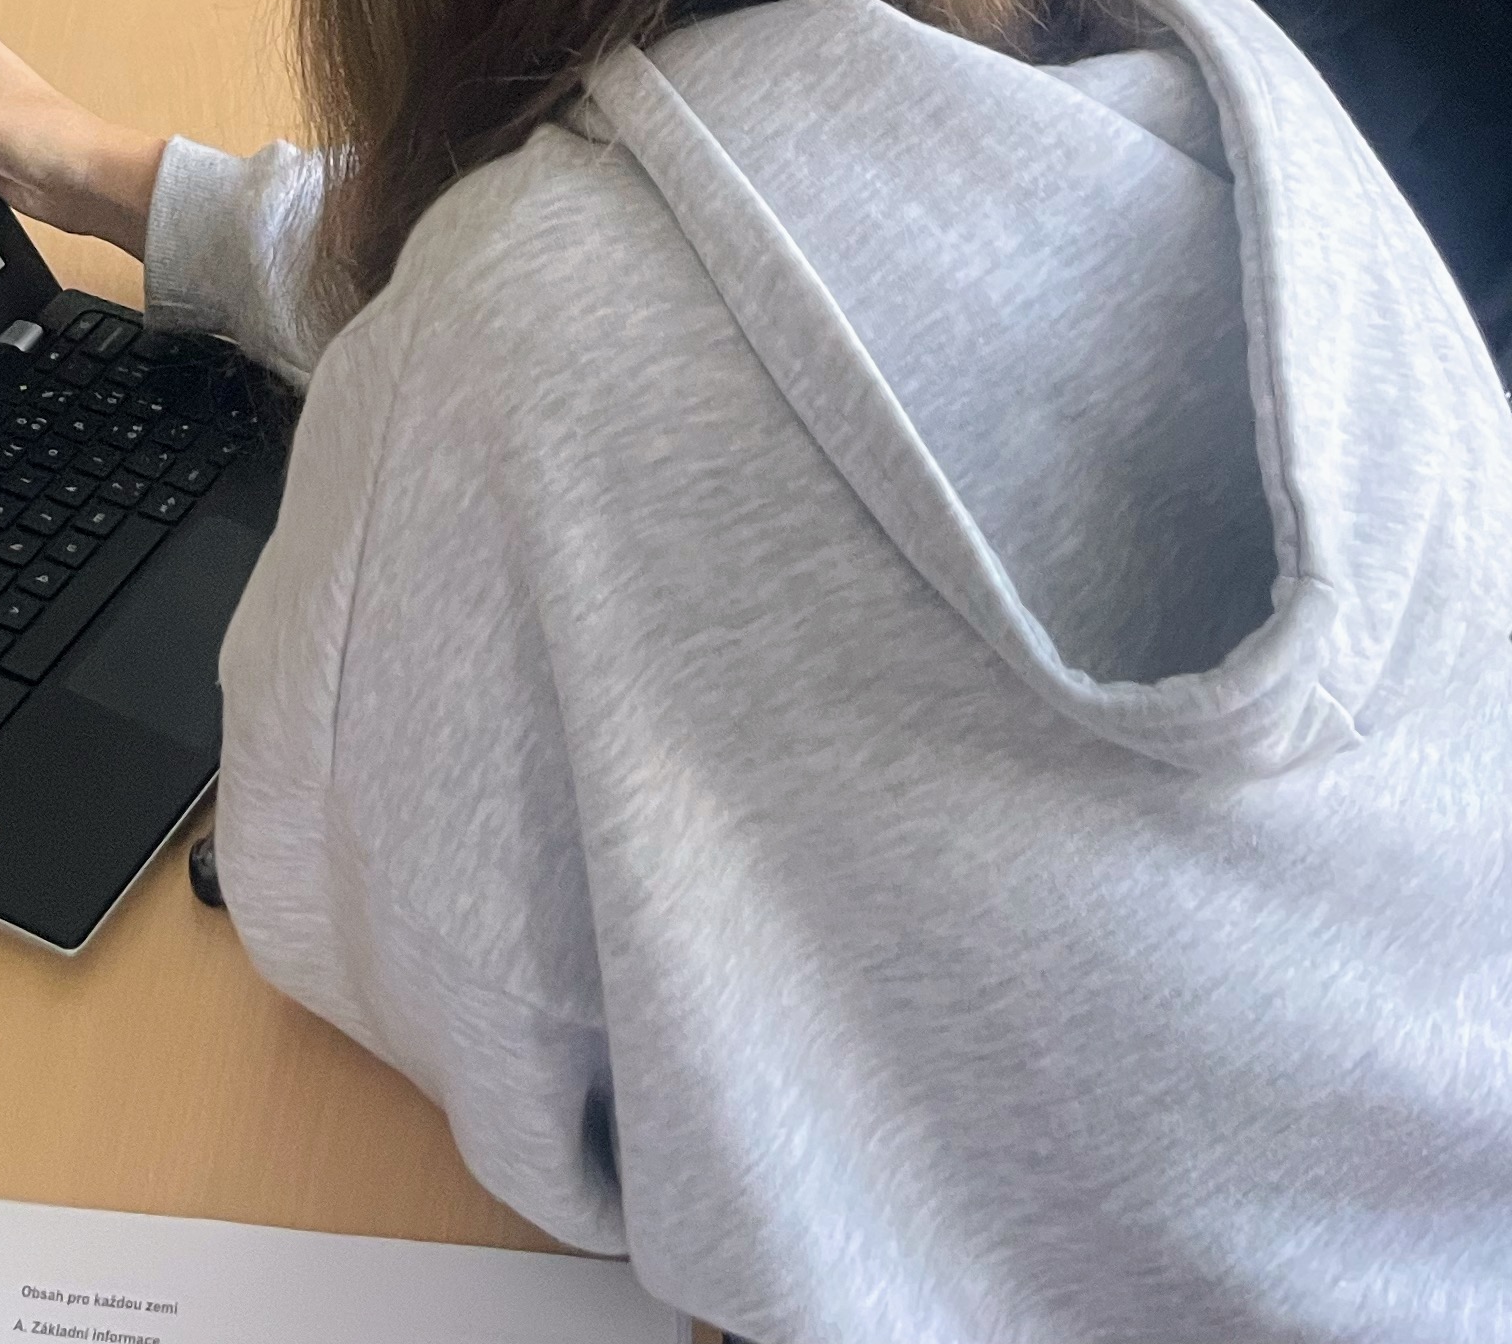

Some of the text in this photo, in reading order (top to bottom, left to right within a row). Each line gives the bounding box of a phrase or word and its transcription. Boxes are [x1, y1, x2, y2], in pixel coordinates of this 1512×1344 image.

[21, 1285, 64, 1303] Obsah
[66, 1292, 90, 1306] pro
[93, 1292, 142, 1311] každou
[13, 1318, 161, 1344] A. Základní informace
